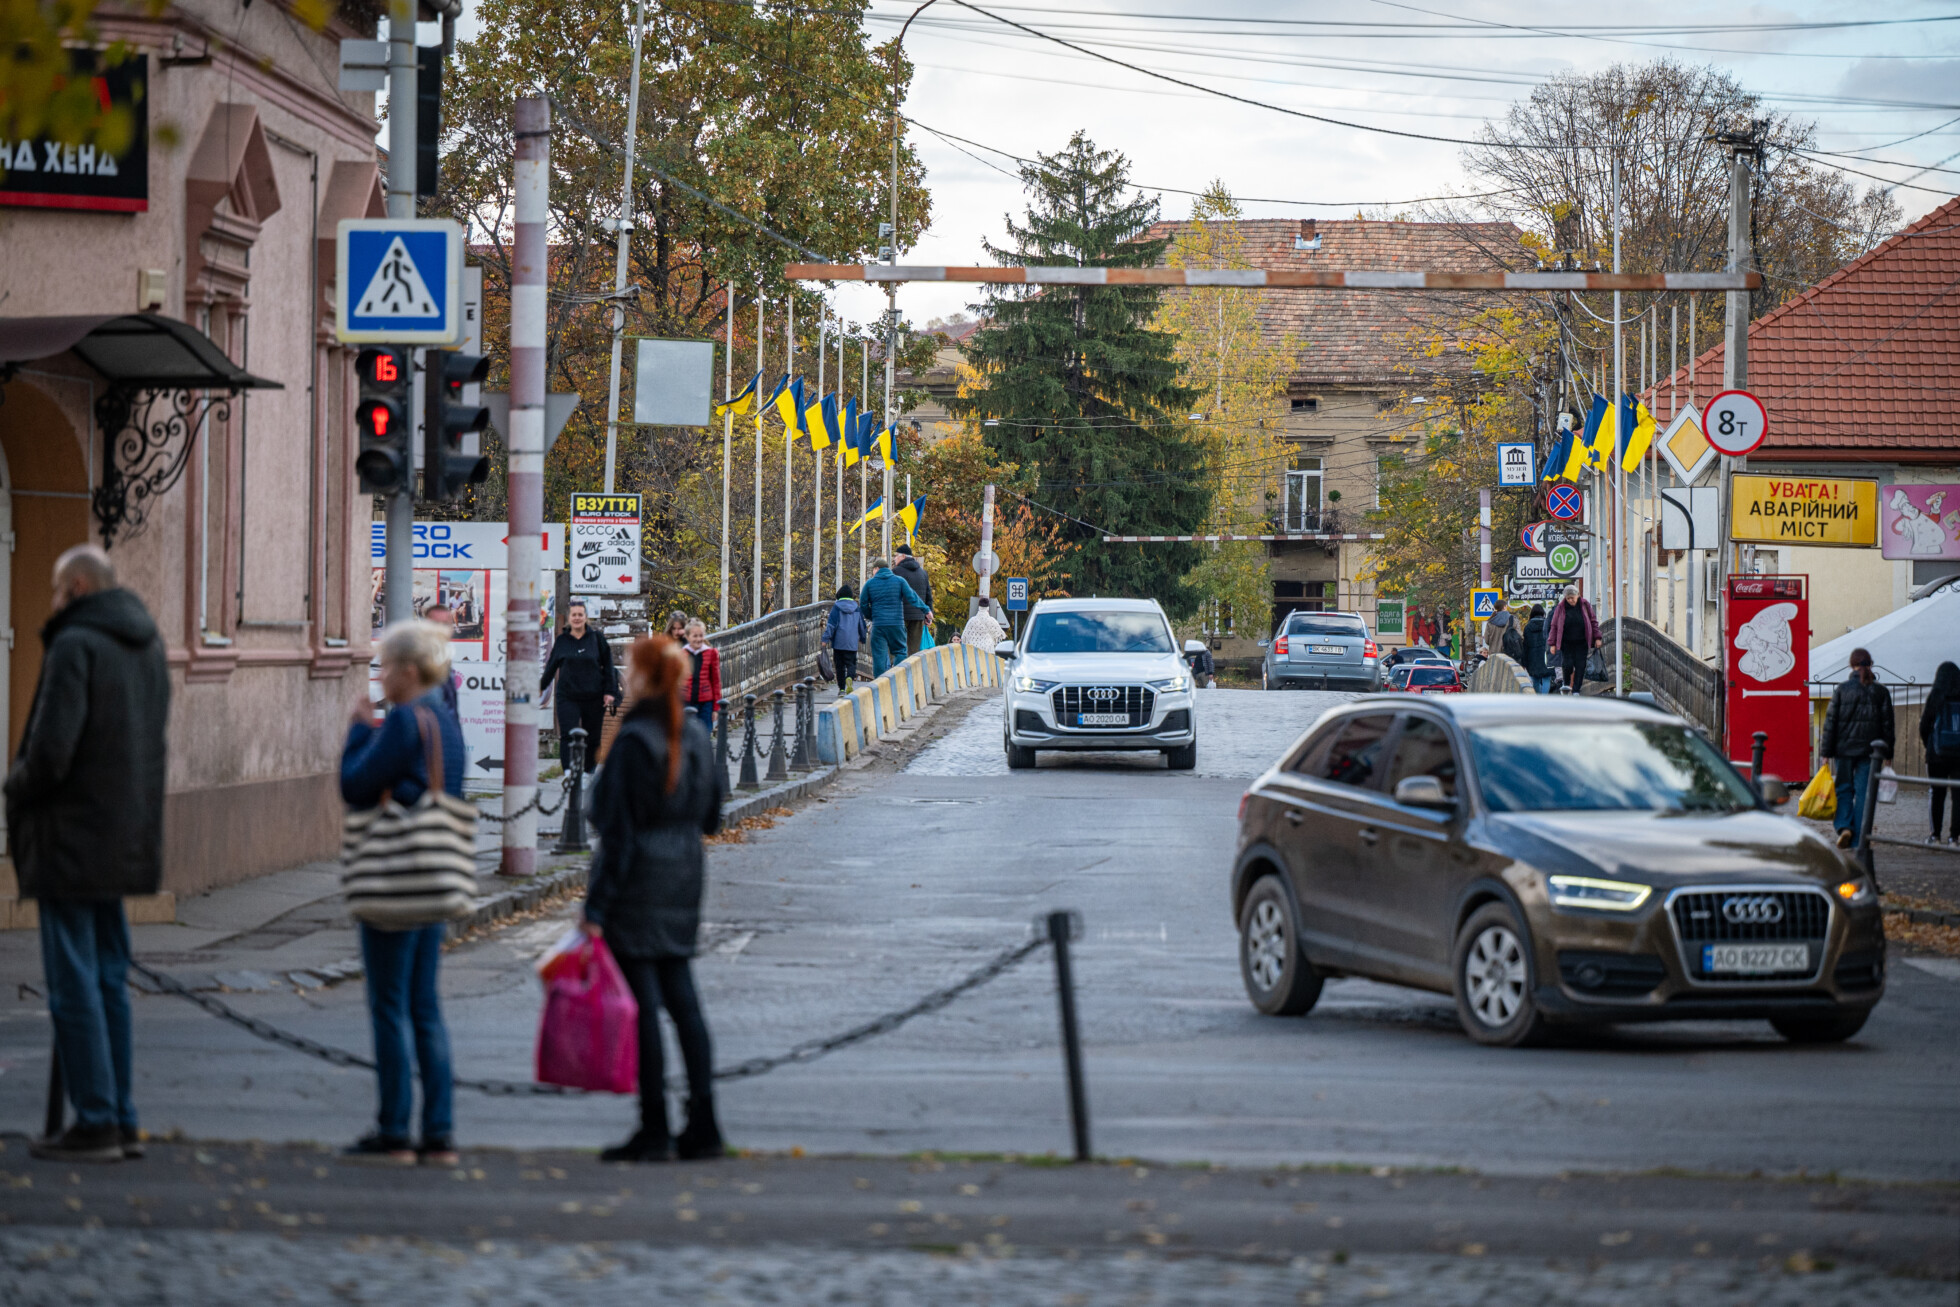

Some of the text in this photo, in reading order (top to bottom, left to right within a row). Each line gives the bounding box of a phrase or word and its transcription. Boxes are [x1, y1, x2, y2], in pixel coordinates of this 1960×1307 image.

[43, 140, 119, 176] ХЕНД
[376, 355, 397, 381] 16
[1768, 481, 1839, 500] УВАГА!
[577, 497, 637, 511] ВЗУТТЯ
[1750, 500, 1859, 521] АВАРІЙНИЙ
[371, 525, 451, 540] ERO
[577, 525, 615, 535] ecco
[1780, 521, 1829, 538] МІСТ
[371, 542, 474, 559] SOCK
[582, 541, 604, 552] NIKE
[598, 556, 626, 566] PUMA
[1735, 583, 1764, 593] Coca-Cola
[1083, 715, 1127, 723] AO 2020 OA
[1714, 949, 1737, 966] AO
[1780, 949, 1803, 966] CK
